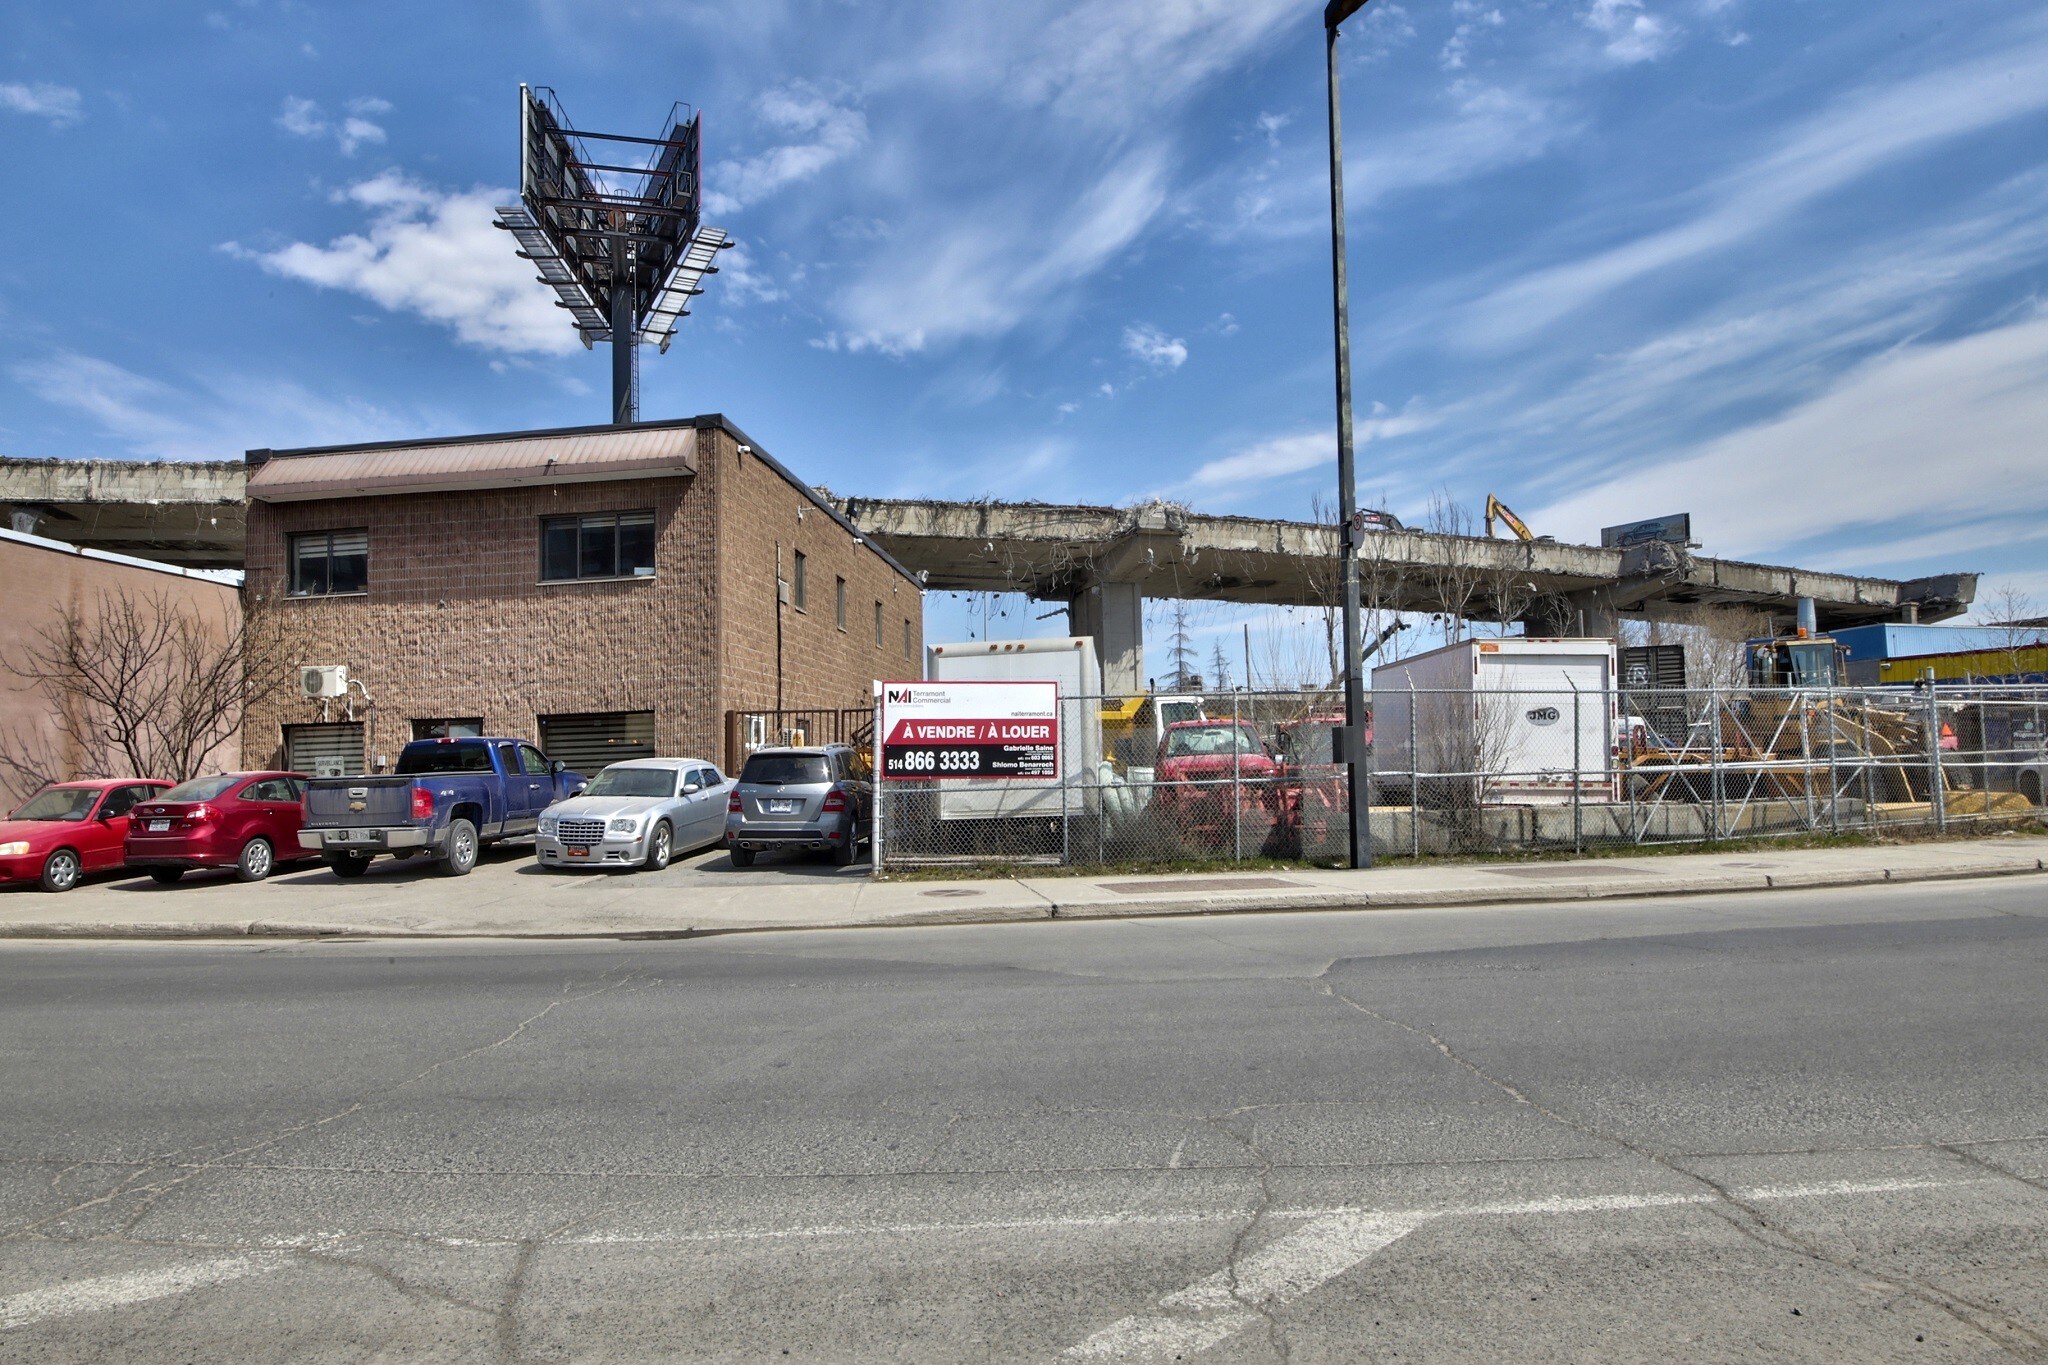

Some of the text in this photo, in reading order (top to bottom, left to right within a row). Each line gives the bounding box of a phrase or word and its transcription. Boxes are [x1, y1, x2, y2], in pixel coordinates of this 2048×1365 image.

[888, 688, 912, 703] NAI
[1529, 711, 1556, 720] JMG
[903, 722, 1050, 740] À VENDRE / À LOUER
[888, 751, 980, 770] 514 866 3333
